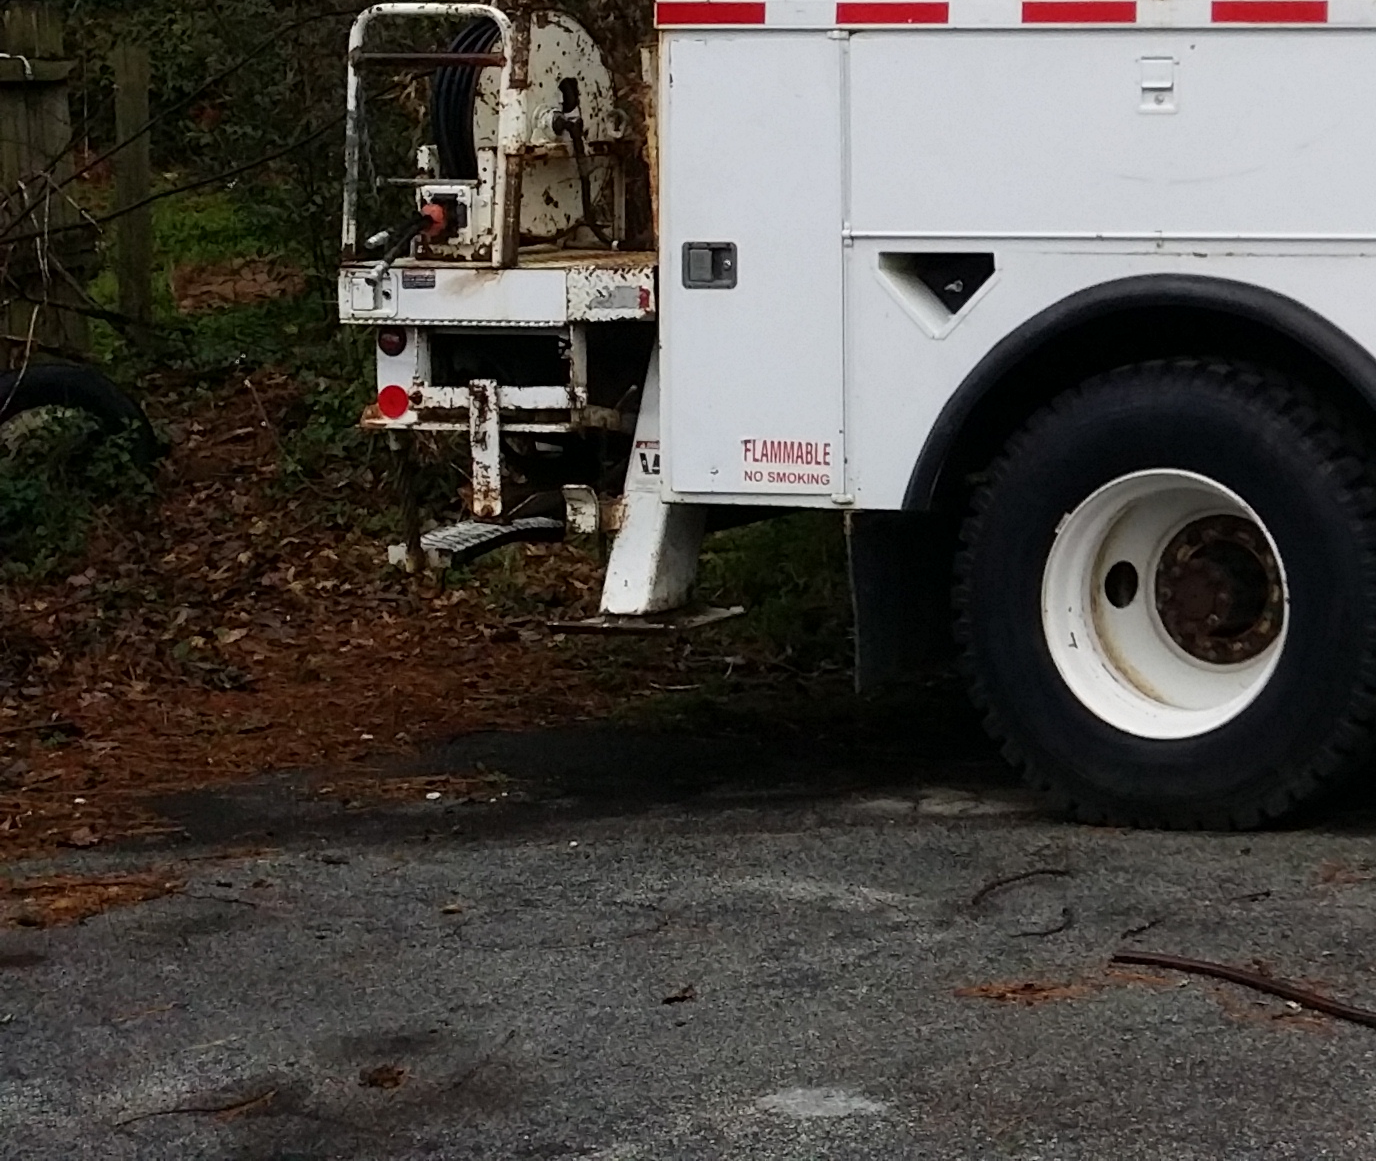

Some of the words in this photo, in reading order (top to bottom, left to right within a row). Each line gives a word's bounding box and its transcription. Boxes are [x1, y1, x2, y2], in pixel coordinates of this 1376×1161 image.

[743, 439, 831, 466] FLAMMABLE
[744, 470, 763, 482] NO
[767, 471, 830, 486] SMOKING
